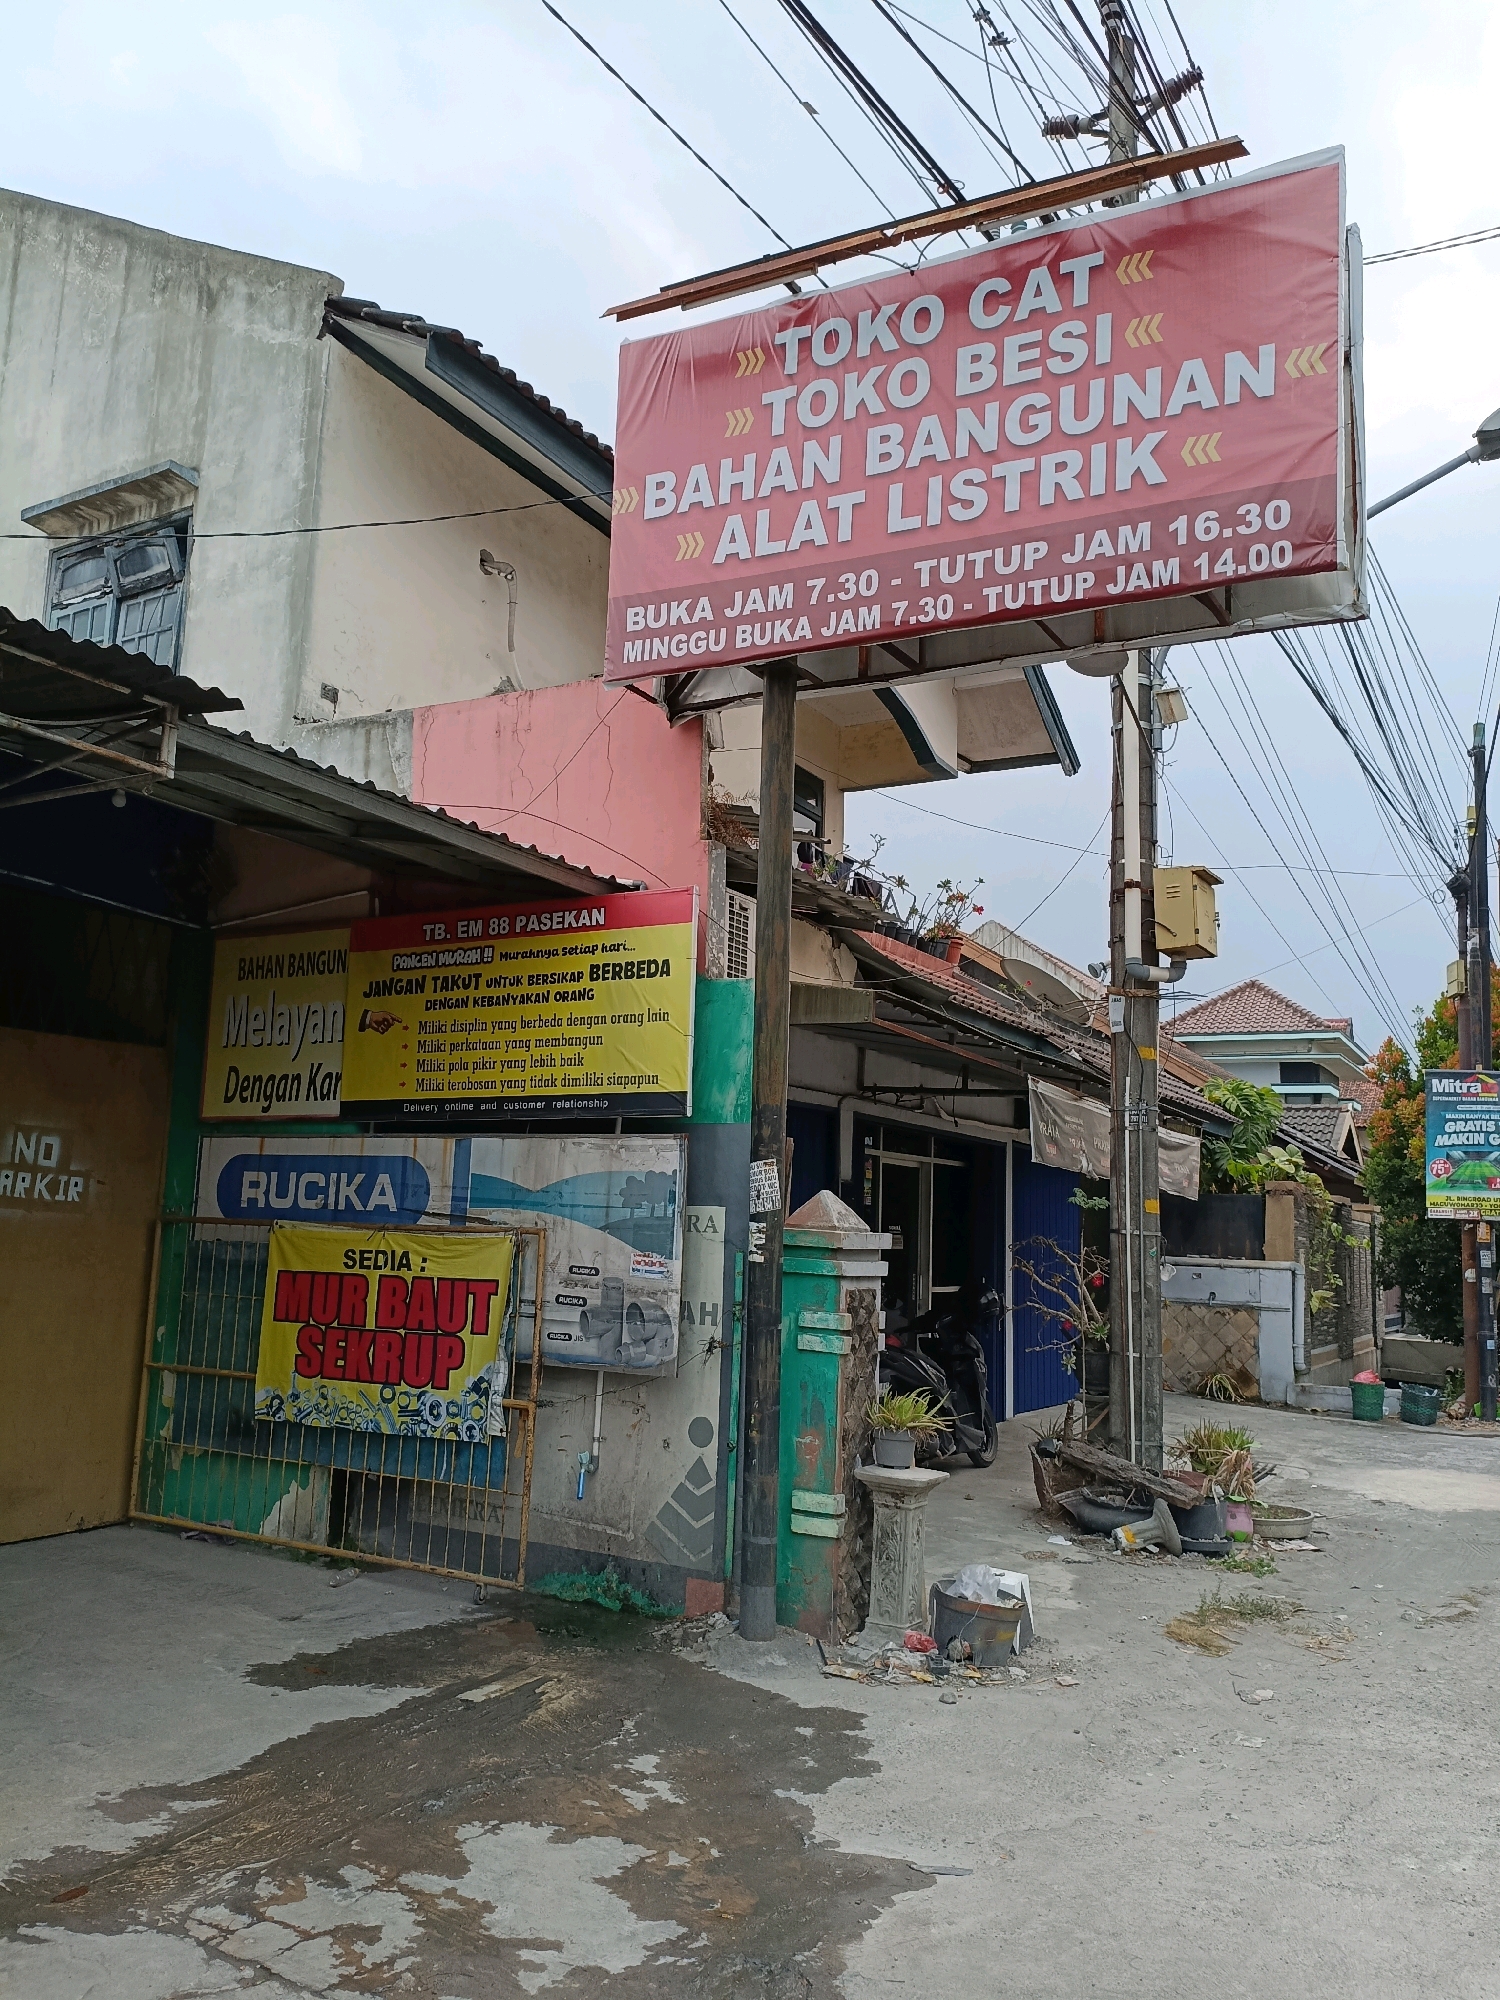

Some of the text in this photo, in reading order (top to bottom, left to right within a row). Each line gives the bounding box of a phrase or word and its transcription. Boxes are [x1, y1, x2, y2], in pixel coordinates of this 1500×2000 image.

[774, 250, 1104, 376] TOKO CAT
[761, 313, 1112, 437] TOKO BESI
[643, 343, 1276, 520] BAHAN BANGUNAN
[712, 430, 1168, 565] ALAT LISTRIK
[626, 596, 713, 633] BUKA
[725, 582, 794, 618] JAM
[807, 568, 879, 605] 7.30
[914, 541, 1048, 588] TUTUP
[1061, 521, 1151, 564] JAM
[1169, 499, 1291, 546] 16.30
[622, 626, 727, 664] MINGGU
[736, 611, 812, 648] BUKA
[821, 604, 881, 636] JAM
[892, 593, 953, 627] 7.30
[983, 571, 1096, 613] TUTUP
[1106, 557, 1179, 594] JAM
[1193, 540, 1293, 581] 14.00
[423, 908, 605, 940] TB. EM 88 PASEKAN
[238, 948, 349, 981] BAHAN BANGUN
[393, 952, 436, 970] PANCEN
[438, 948, 481, 966] MURAH
[562, 943, 598, 957] setiap
[363, 959, 670, 998] JANGAN TAKUT UNTUK BERSIKAP BERBEDA
[425, 987, 595, 1011] DENGAN KEBANYAKAN ORANG
[222, 989, 345, 1062] Melayan
[418, 1008, 669, 1036] Miliki disiplin yang berbeda dengan orang lain
[417, 1033, 603, 1055] Miliki perkataan yang membangun
[416, 1051, 584, 1075] Miliki pola pikir yang lebih baik
[224, 1066, 301, 1113] Dengan
[415, 1070, 660, 1092] Miliki terobosan yang tidak dimiliki siapapun
[403, 1098, 608, 1112] Delivery ontime and customer relationship
[1434, 1132, 1485, 1147] MAKIN
[1445, 1120, 1496, 1132] GRATIS
[14, 1131, 61, 1168] NO
[240, 1171, 397, 1212] RUCIKA
[343, 1248, 412, 1271] SEDIA
[273, 1269, 500, 1336] MUR BAUT
[295, 1323, 466, 1390] SEKRUP
